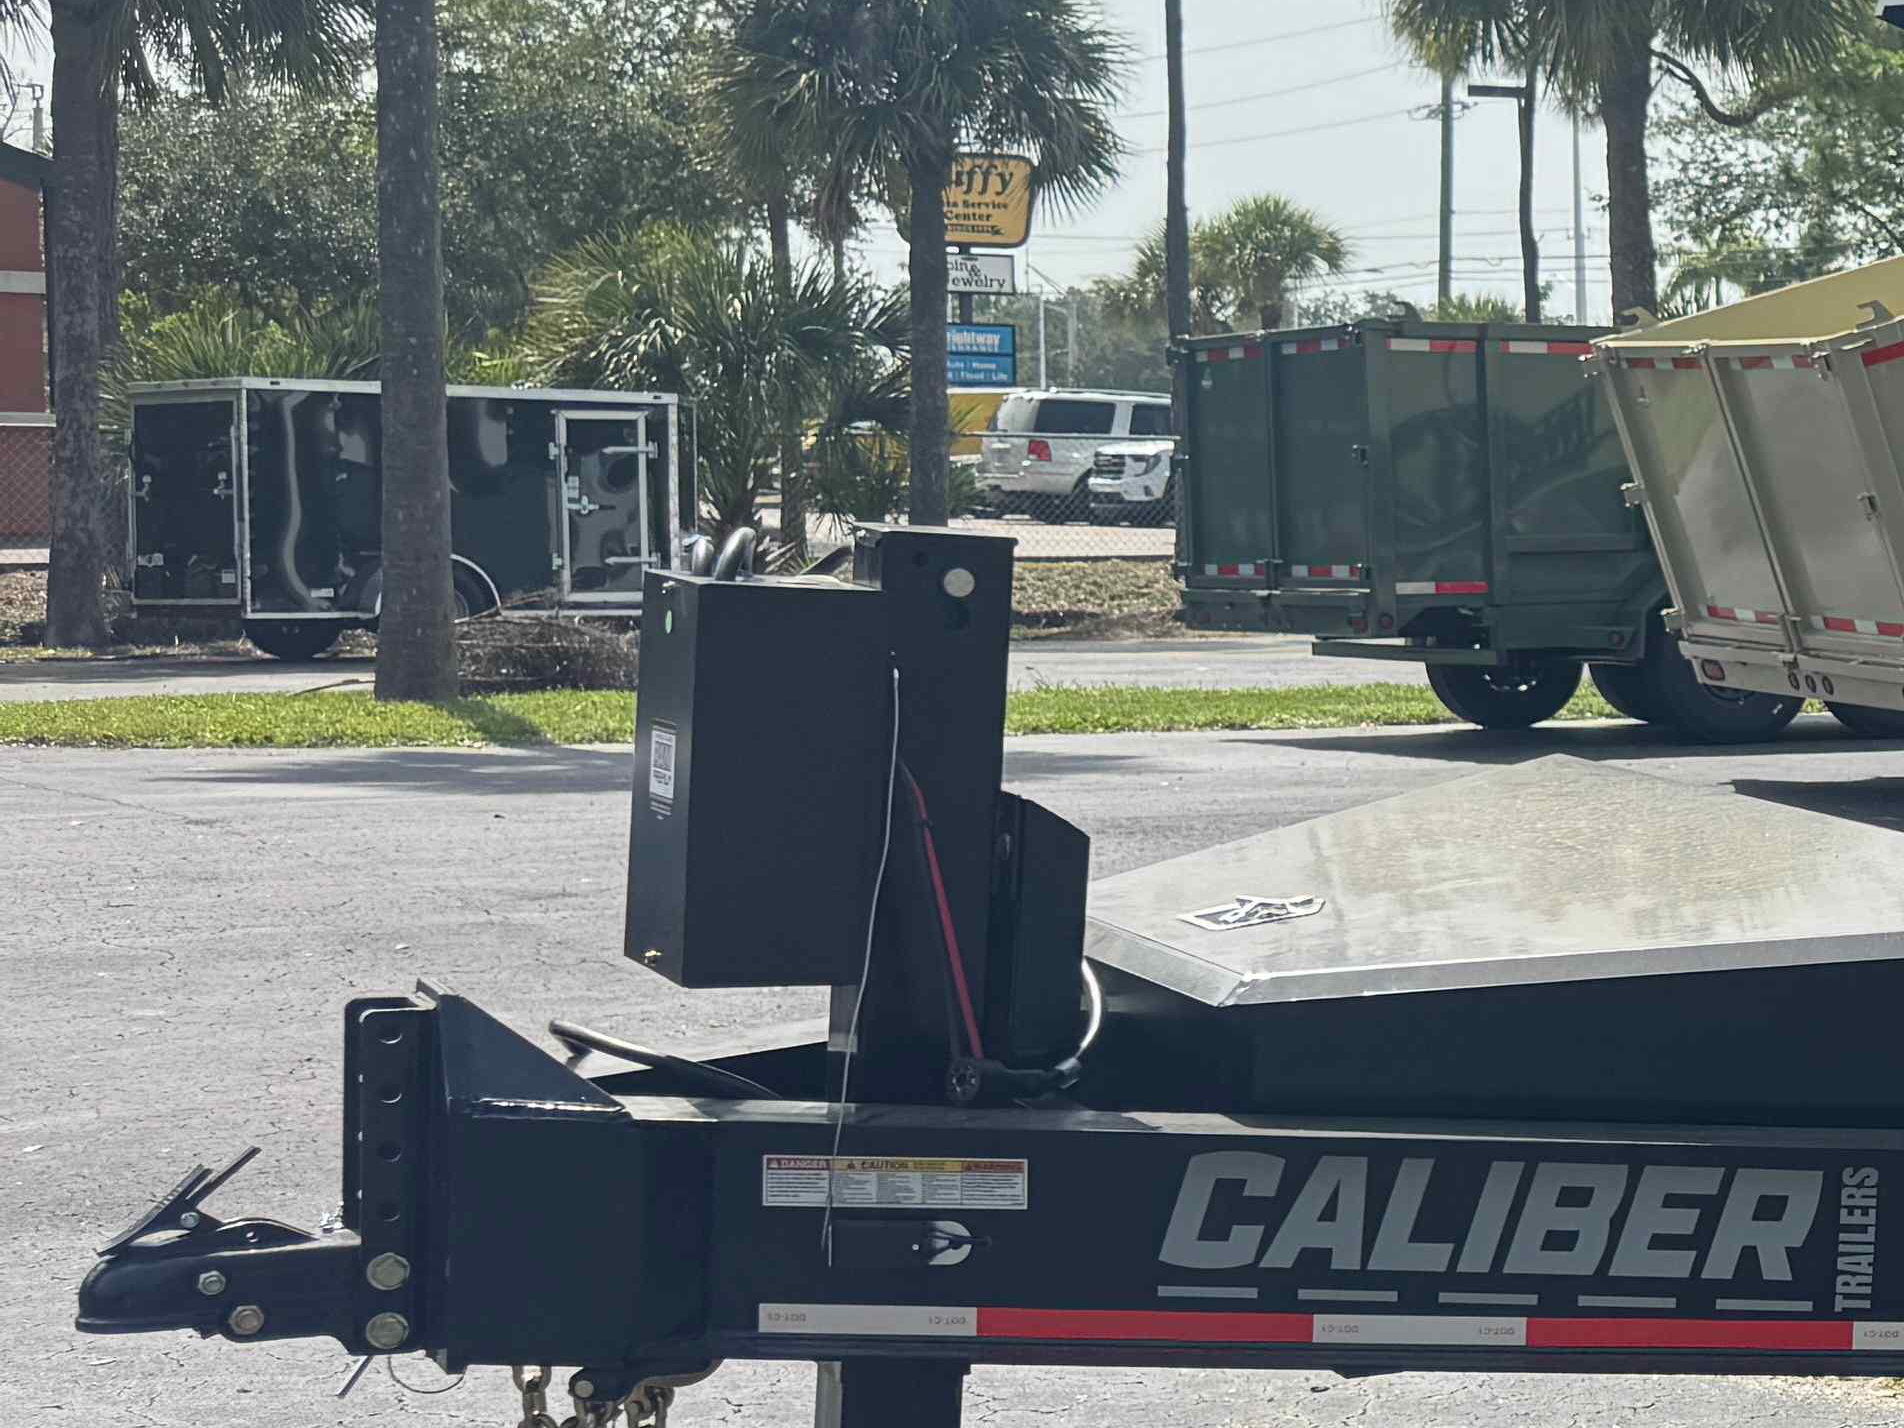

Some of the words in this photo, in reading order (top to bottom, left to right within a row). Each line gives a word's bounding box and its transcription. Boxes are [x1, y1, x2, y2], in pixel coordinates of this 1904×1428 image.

[953, 164, 1014, 196] iffy
[962, 199, 1009, 211] Service
[944, 210, 993, 222] Center
[951, 275, 1006, 289] ewelry
[946, 329, 1001, 346] rightway
[780, 1160, 827, 1170] DANGER
[860, 1160, 911, 1171] CAUTION
[1157, 1150, 1824, 1281] CALIBER
[1834, 1166, 1879, 1312] TRAILERS
